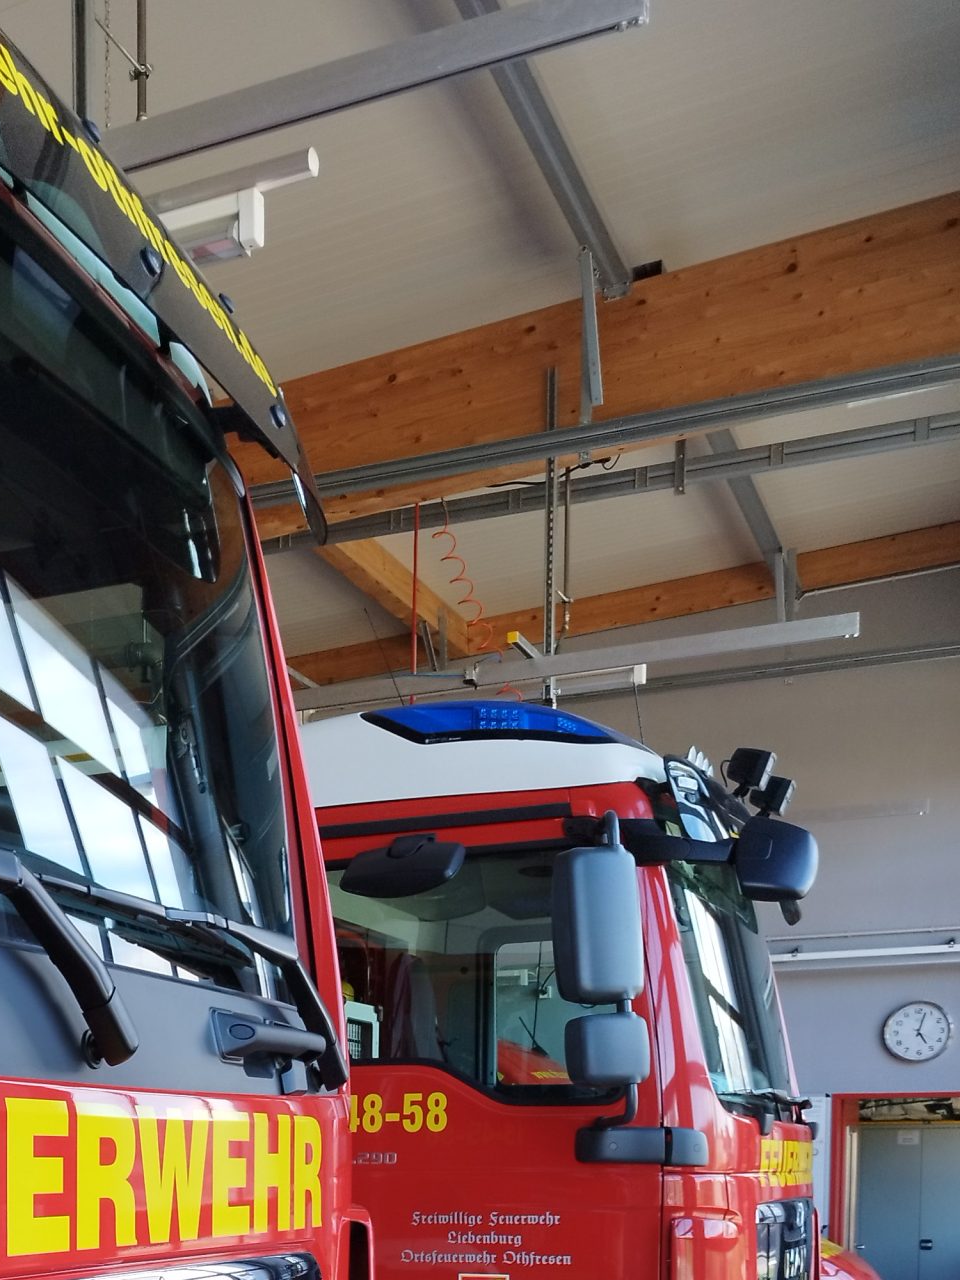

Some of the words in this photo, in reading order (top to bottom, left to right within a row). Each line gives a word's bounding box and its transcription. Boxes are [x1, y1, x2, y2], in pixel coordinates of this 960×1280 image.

[411, 1211, 483, 1227] Freiwillige
[488, 1211, 561, 1227] Feuerwehr
[447, 1231, 522, 1247] Liebenburg
[400, 1249, 497, 1265] Ortsfeuerwehr
[502, 1250, 572, 1267] Othfresen
